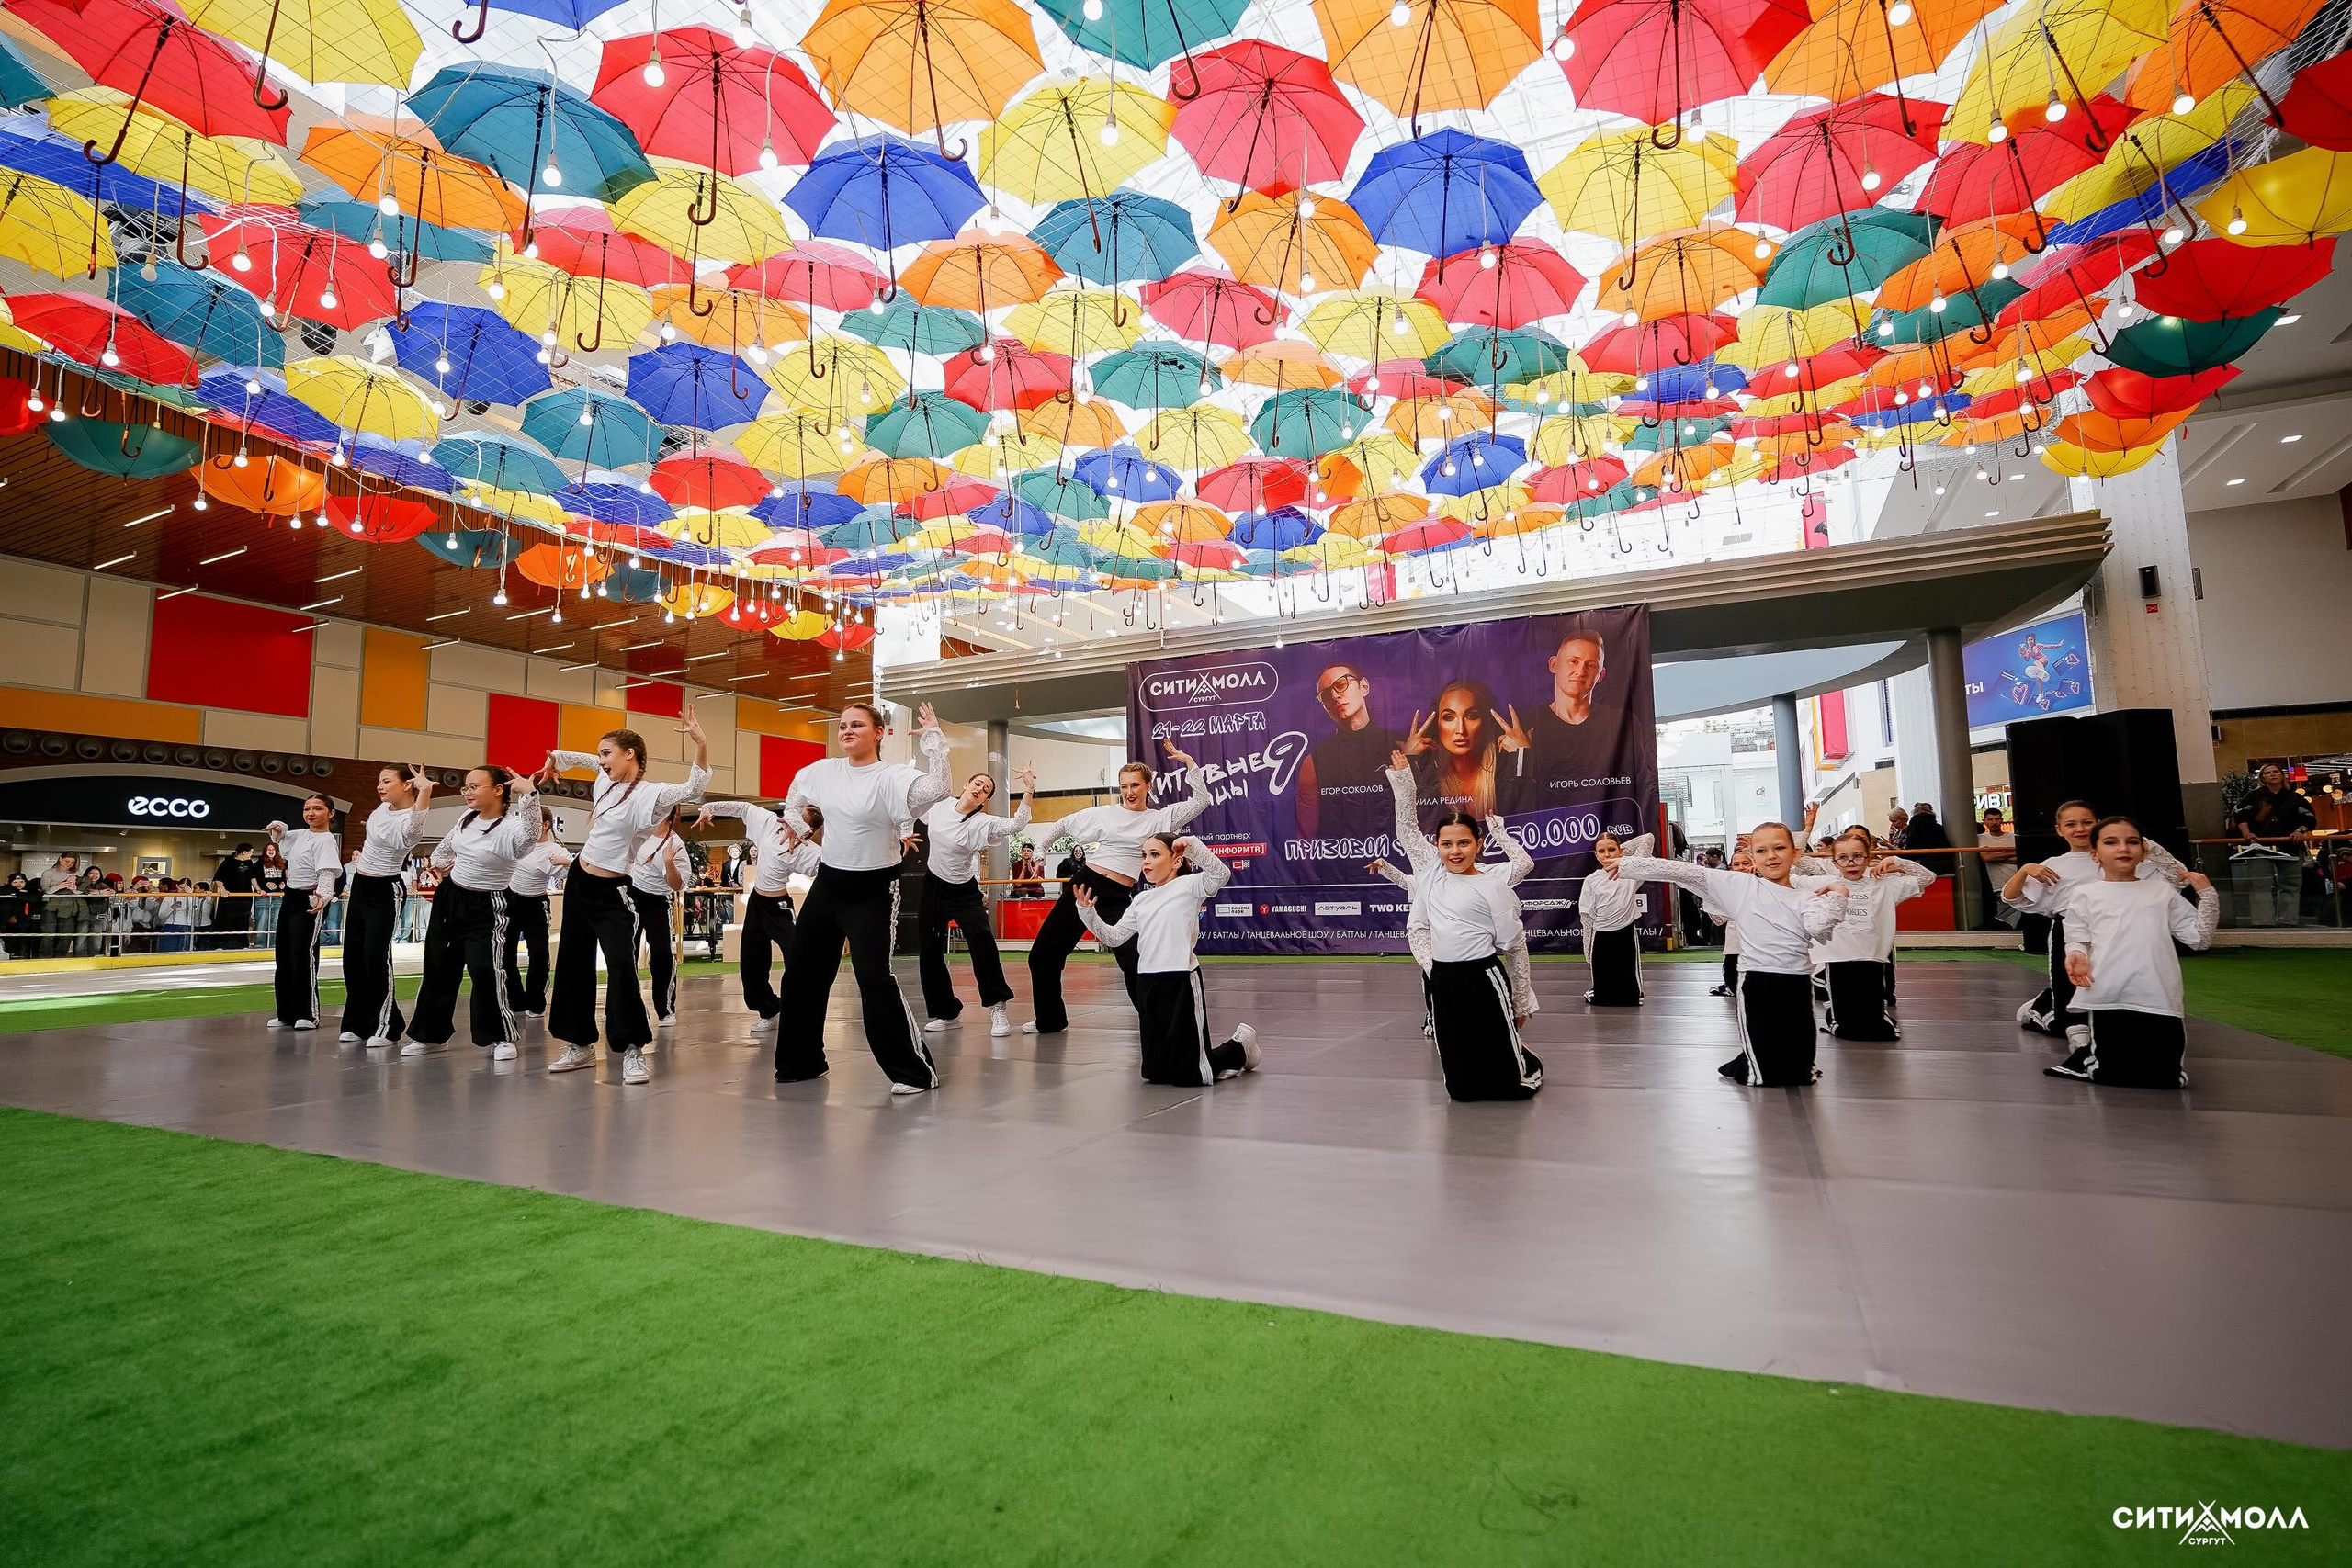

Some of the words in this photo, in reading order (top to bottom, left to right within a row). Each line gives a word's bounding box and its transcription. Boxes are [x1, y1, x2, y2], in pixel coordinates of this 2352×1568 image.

[1193, 694, 1216, 703] СУРГУТ
[1151, 718, 1206, 740] 21-22
[1209, 710, 1266, 735] МАРТА
[1549, 778, 1579, 789] ИГОРЬ
[1581, 775, 1632, 788] СОЛОВЬЕВ
[1320, 786, 1340, 796] ЕГОР
[1340, 784, 1384, 795] СОКОЛОВ
[1440, 795, 1475, 805] РЕДИНА
[127, 795, 210, 818] ecco
[1284, 833, 1390, 862] ПРИЗОВОЙ
[1272, 905, 1307, 914] YAMAGUCHI
[1369, 904, 1394, 913] TWO
[1396, 903, 1413, 913] KE
[1213, 931, 1239, 939] БАТТЛЫ
[1246, 931, 1306, 940] ТАНЦЕВАЛЬНОЕ
[1308, 930, 1329, 939] ШОУ
[1337, 930, 1366, 939] БАТТЛЫ
